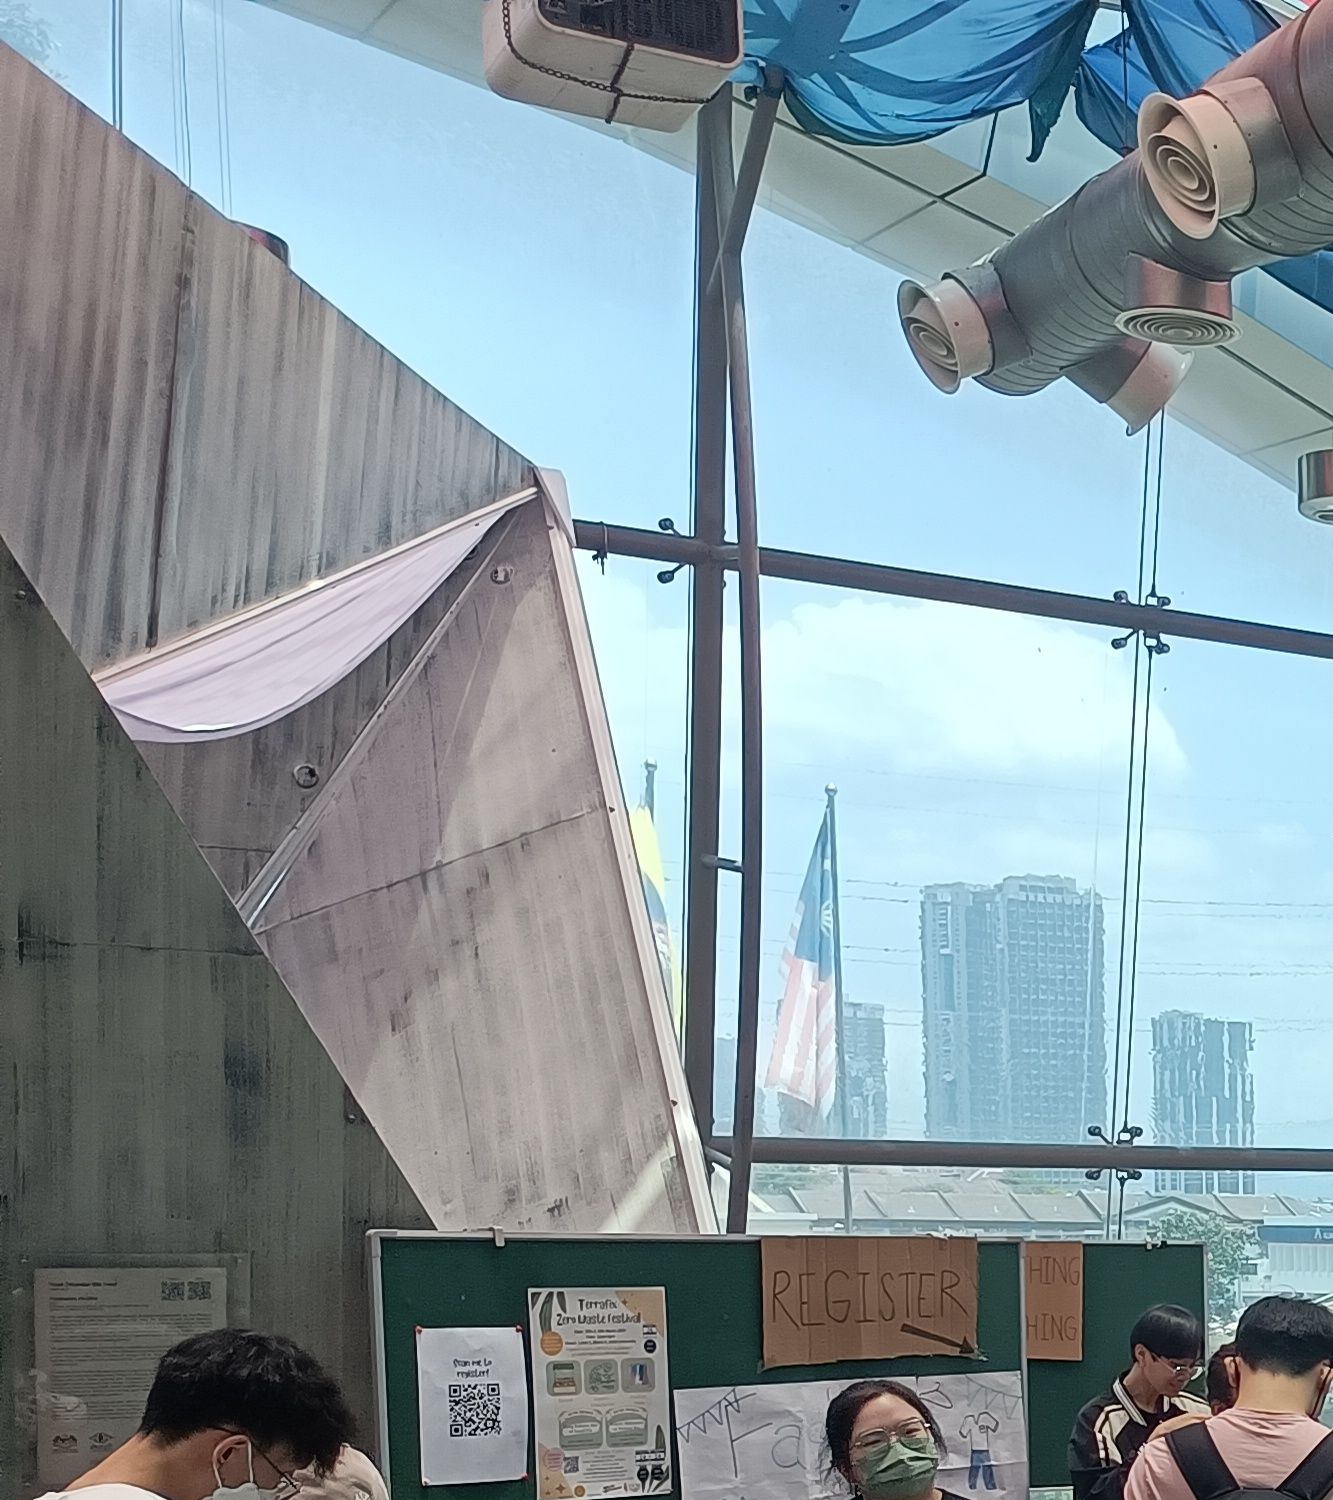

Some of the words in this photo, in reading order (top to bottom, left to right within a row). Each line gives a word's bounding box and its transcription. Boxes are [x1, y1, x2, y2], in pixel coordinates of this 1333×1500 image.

[1026, 1256, 1081, 1286] HING
[577, 1298, 618, 1312] Terrafix
[772, 1269, 969, 1328] REGISTER
[556, 1313, 576, 1326] Zero
[577, 1313, 606, 1325] Waste
